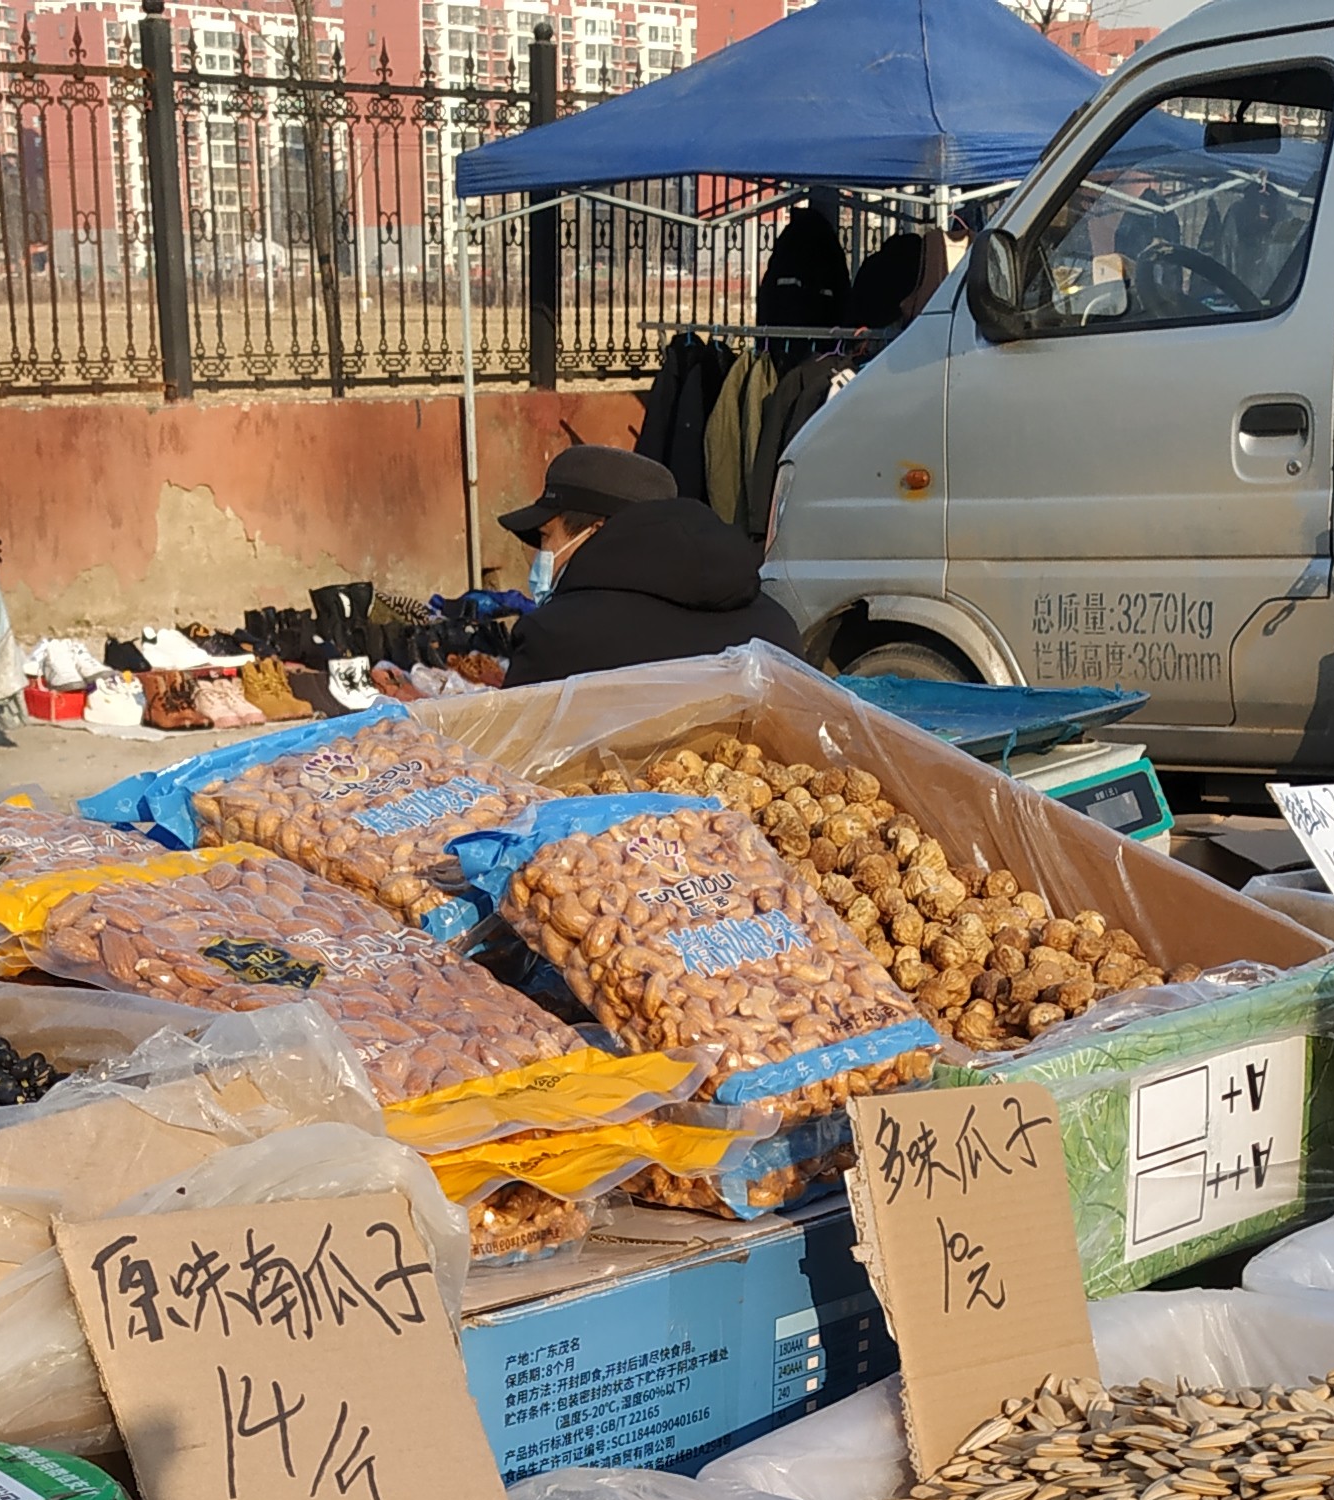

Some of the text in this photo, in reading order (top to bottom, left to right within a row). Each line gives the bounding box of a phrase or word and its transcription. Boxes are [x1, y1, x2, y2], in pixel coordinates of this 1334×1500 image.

[1221, 1058, 1269, 1113] A+
[875, 1097, 1052, 1205] 多味瓜子
[1207, 1136, 1273, 1199] A++
[91, 1222, 433, 1350] 原味南瓜子
[936, 1216, 1006, 1314] 10元
[505, 1336, 581, 1371] 产地:广东茂名
[505, 1357, 576, 1389] 保质期:8个月
[631, 1405, 661, 1426] 22165
